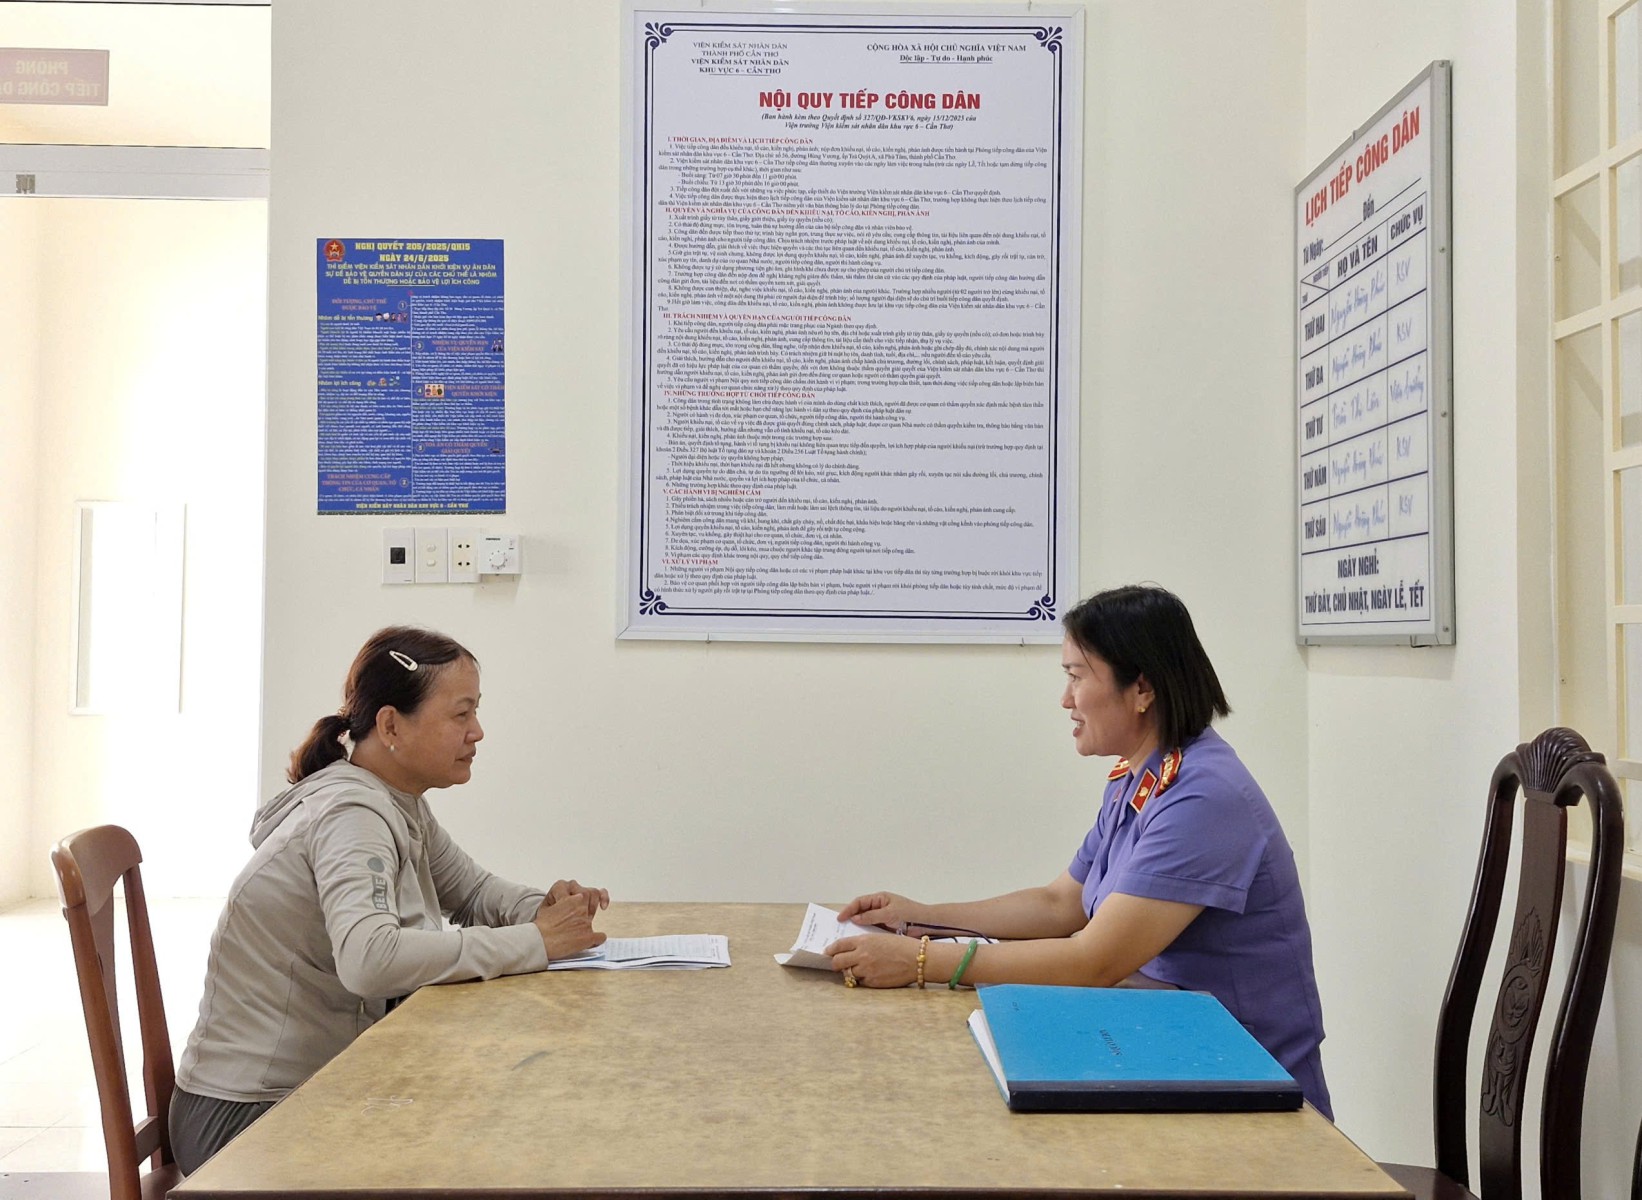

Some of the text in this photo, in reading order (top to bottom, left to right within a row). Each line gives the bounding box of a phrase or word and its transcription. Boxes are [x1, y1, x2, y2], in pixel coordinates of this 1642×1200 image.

[924, 44, 939, 52] HỘI
[977, 55, 993, 63] phúc
[760, 88, 980, 111] NỘI QUY TIẾP CÔNG DÂN
[1306, 106, 1419, 227] LỊCH TIẾP CÔNG DÂN
[1363, 194, 1374, 221] Đến
[1391, 205, 1423, 240] CHỨC VỤ
[355, 241, 470, 252] NGHỊ QUYẾT 205/2025/QH15
[380, 253, 401, 261] NGÀY
[1338, 257, 1347, 278] HỌ
[1350, 245, 1360, 269] VÀ
[1362, 235, 1377, 260] TÊN
[1305, 314, 1324, 341] THỨ HAI
[1306, 366, 1315, 391] THỨ
[1316, 365, 1323, 385] BA
[1306, 414, 1323, 440] THỨ TƯ
[1304, 465, 1326, 490] THỨ NĂM
[1305, 516, 1314, 539] THỨ
[1316, 515, 1326, 537] SÁU
[1338, 548, 1379, 578] NGÀY NGHỈ:
[1306, 579, 1424, 615] THỨ BẢY, CHỦ NHẬT, NGÀY LỄ, TẾT
